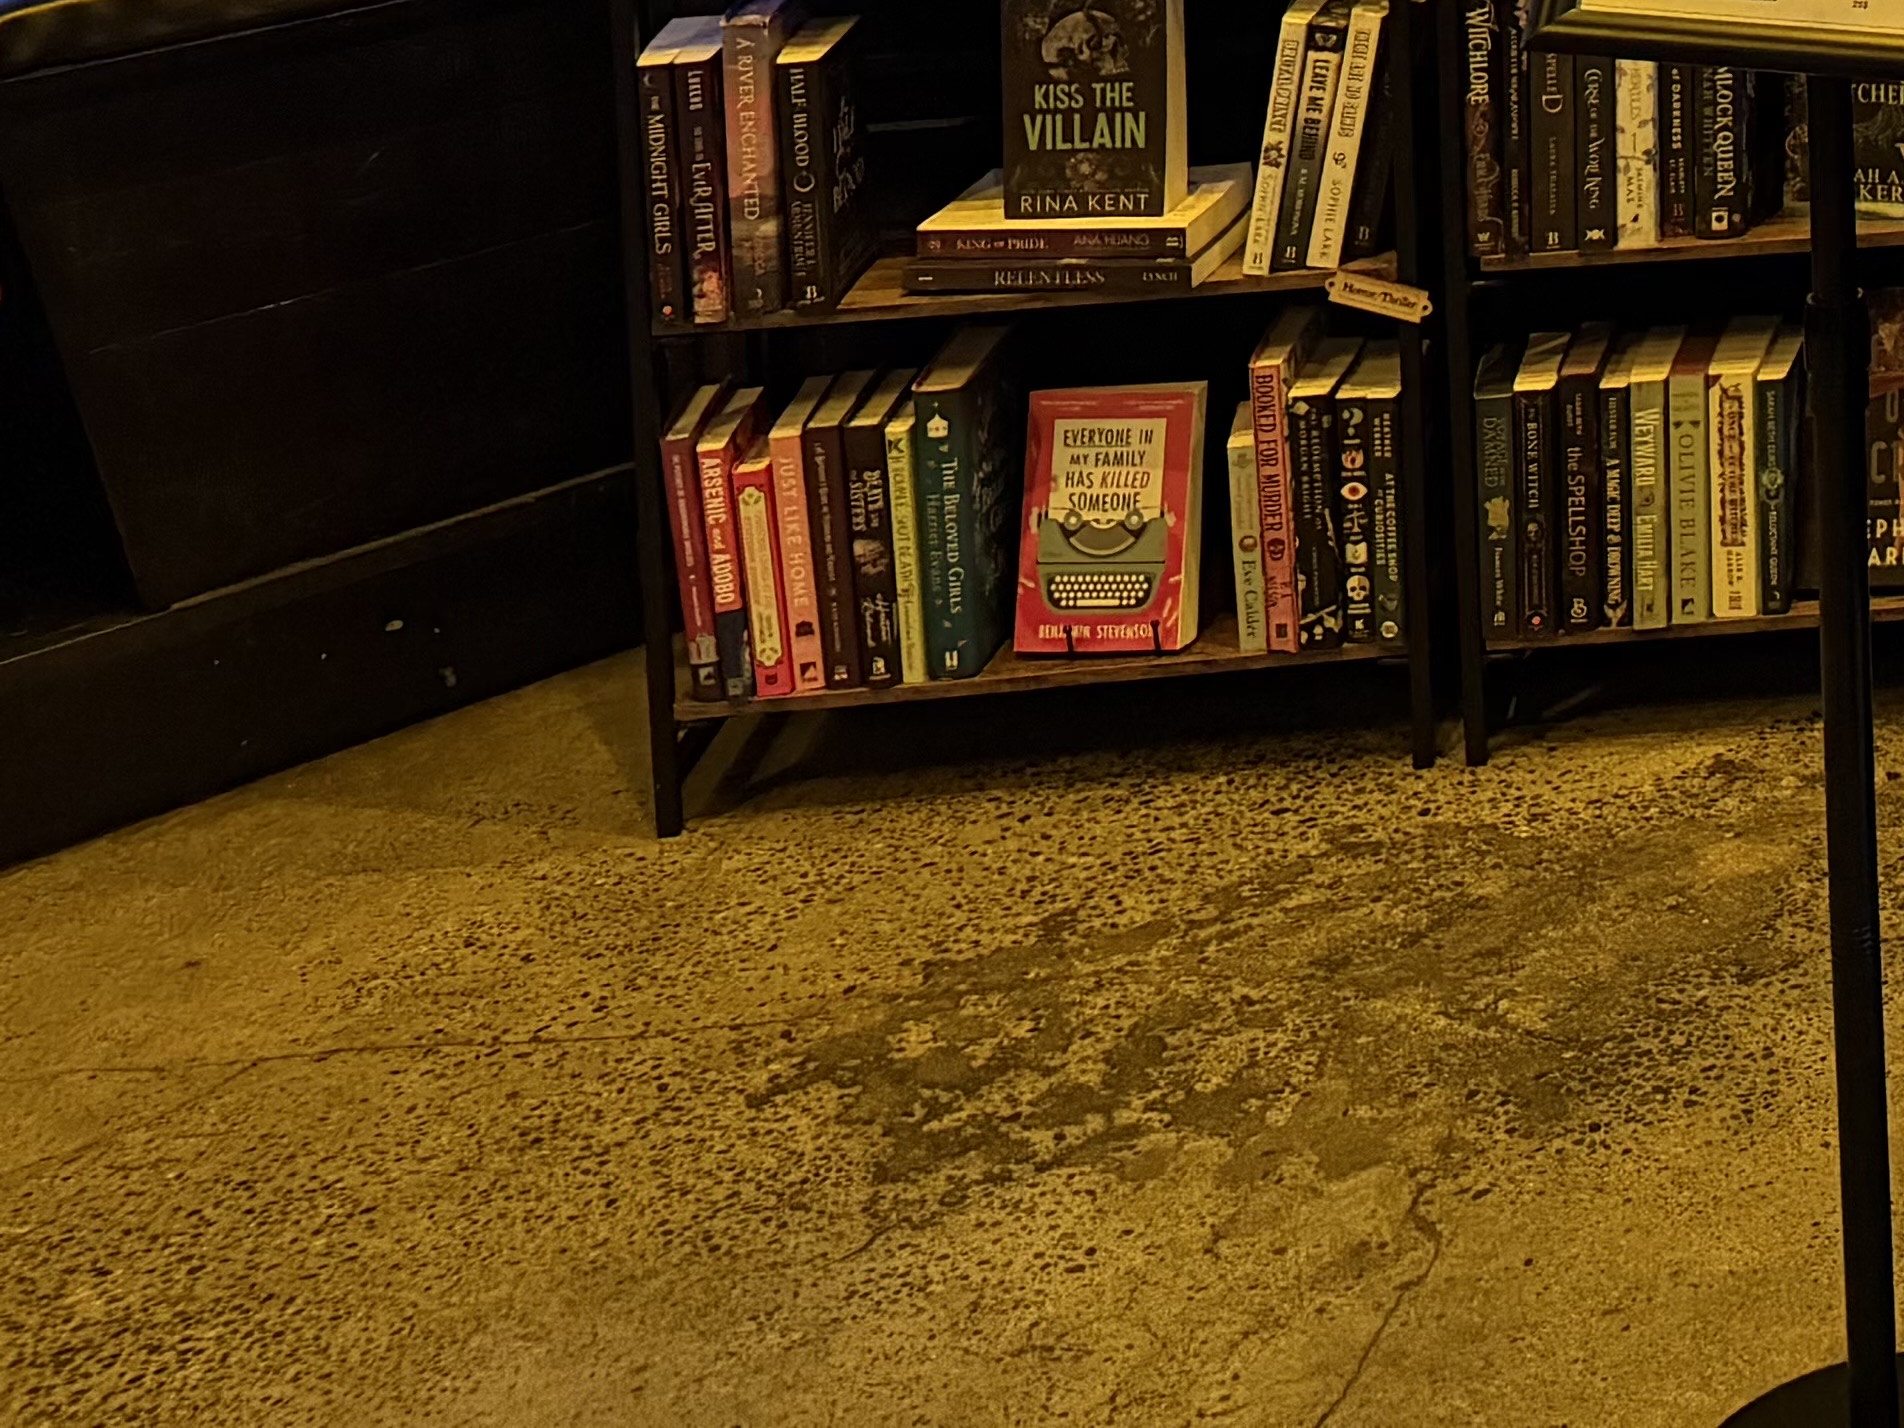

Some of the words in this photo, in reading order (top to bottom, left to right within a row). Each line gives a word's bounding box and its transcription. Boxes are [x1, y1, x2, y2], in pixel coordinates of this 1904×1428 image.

[735, 38, 748, 49] A
[1276, 39, 1299, 86] BRUTAL
[1464, 6, 1494, 106] WITCHLORE
[736, 56, 755, 109] RIVER
[789, 68, 805, 108] HALF
[1033, 83, 1084, 109] KISS
[1092, 81, 1135, 108] THE
[1308, 58, 1331, 93] LEAVE
[1270, 86, 1291, 133] PRINCE
[1306, 95, 1324, 114] ME
[793, 114, 809, 167] BLOOD
[1023, 110, 1147, 152] VILLAIN
[1299, 117, 1322, 162] BEHIND
[740, 111, 760, 221] ENCHANTED
[1019, 194, 1076, 213] RINA
[1088, 192, 1150, 213] KENT
[1323, 179, 1343, 224] SOPHIE
[956, 238, 991, 251] KING
[1007, 237, 1049, 251] PRIDE
[1318, 227, 1334, 260] LARK
[993, 270, 1106, 286] RELENTLESS
[1142, 270, 1178, 283] LYNCH
[1254, 374, 1278, 434] BOOKED
[1062, 428, 1134, 447] EVERYONE
[1139, 428, 1153, 445] IN
[1069, 453, 1090, 466] MY
[1094, 452, 1147, 467] FAMILY
[1260, 439, 1280, 469] FOR
[1482, 416, 1500, 488] DAMNED
[1526, 421, 1539, 460] BONE
[1566, 446, 1584, 471] the
[1634, 407, 1660, 486] WEYWARD
[700, 457, 726, 524] ARSENIC
[777, 456, 796, 499] JUST
[941, 456, 960, 491] THE
[1065, 471, 1095, 489] HAS
[1099, 471, 1150, 489] KILLED
[1527, 464, 1540, 509] WITCH
[1678, 433, 1695, 509] OLIVIE
[925, 492, 942, 546] Harriet
[1068, 492, 1140, 513] SOMEONE
[1263, 473, 1284, 532] MURDER
[783, 505, 802, 546] LIKE
[942, 493, 962, 563] BELOVED
[1567, 474, 1588, 577] SPELLSHOP
[1636, 514, 1657, 559] EMILIA
[929, 549, 944, 592] Evans
[1242, 559, 1257, 586] Eve
[1679, 518, 1697, 589] BLAKE
[712, 552, 736, 604] ADOBO
[787, 550, 810, 608] HOME
[946, 565, 966, 615] GIRLS
[1636, 560, 1657, 592] HART
[1242, 589, 1260, 638] Calder
